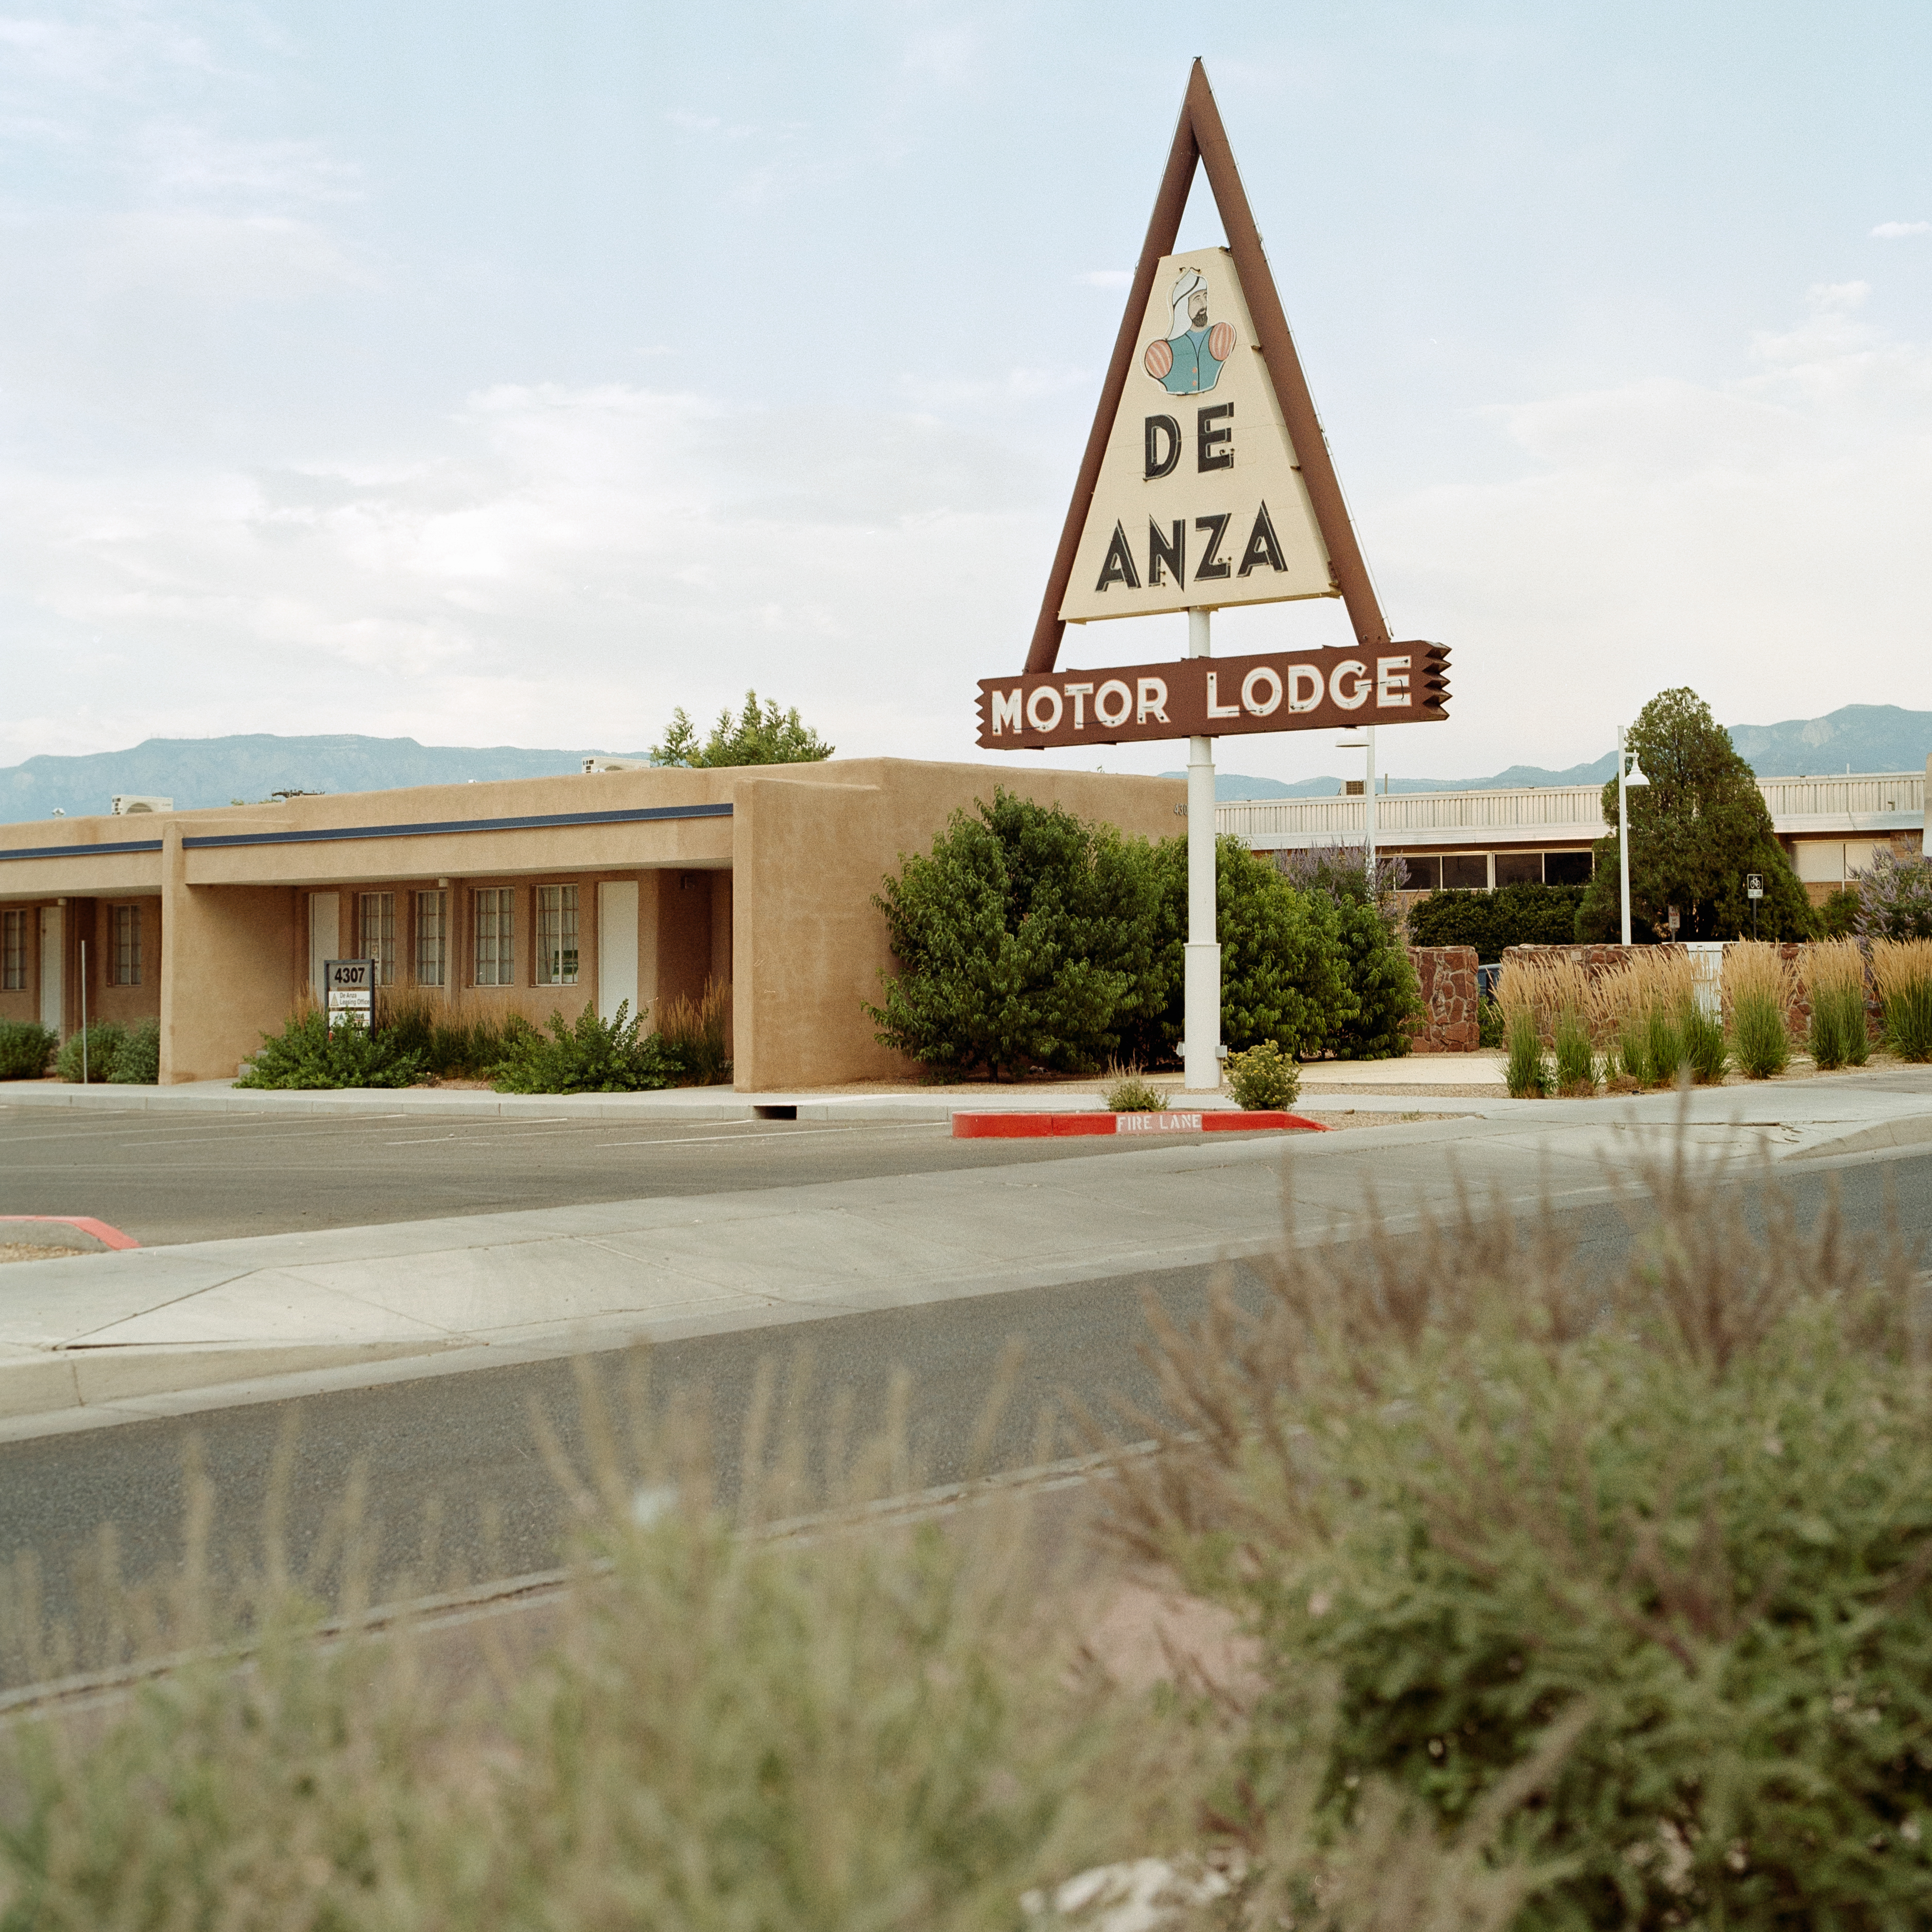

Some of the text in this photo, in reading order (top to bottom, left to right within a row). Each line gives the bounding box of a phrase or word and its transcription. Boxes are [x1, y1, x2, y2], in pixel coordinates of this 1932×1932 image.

[1144, 402, 1234, 480] DE
[1095, 498, 1288, 593] ANZA
[991, 655, 1413, 736] MOTOR LODGE
[335, 967, 365, 983] 4307
[1117, 1114, 1201, 1132] FIRE LANE
